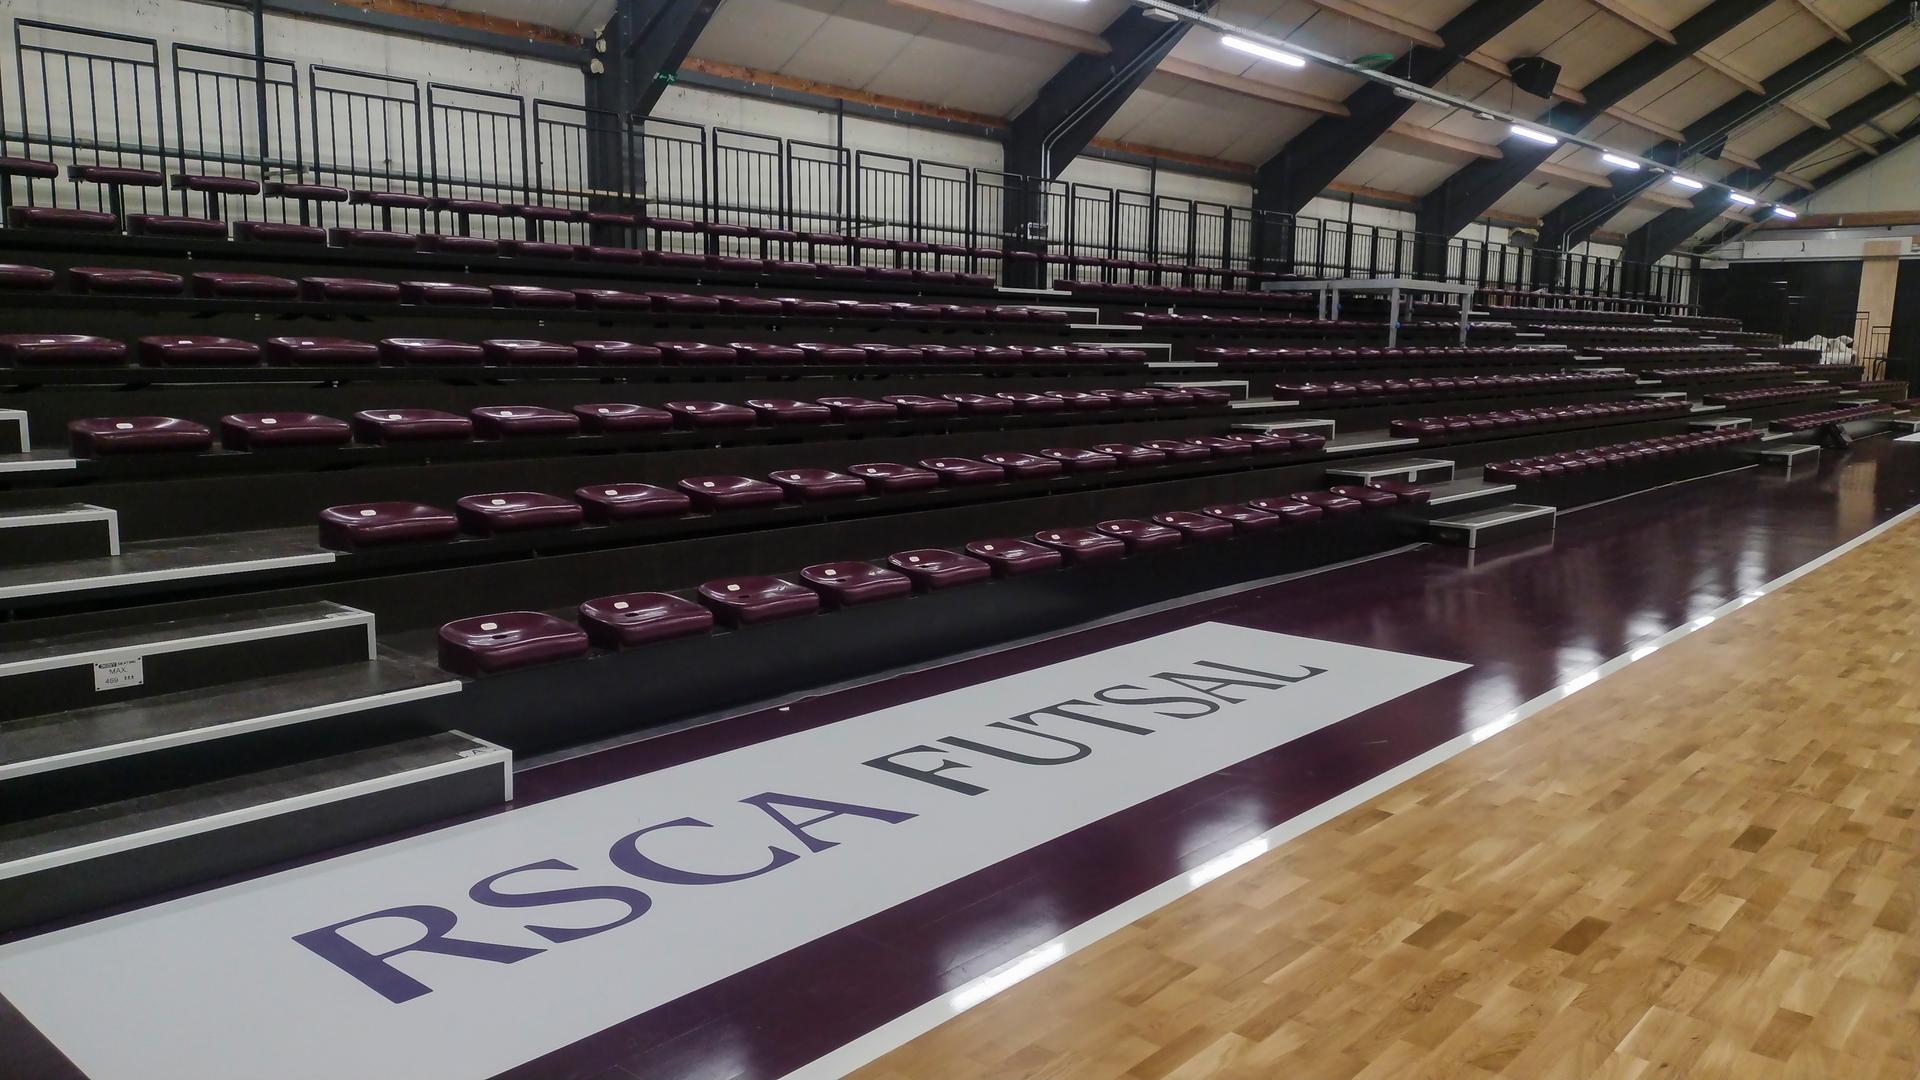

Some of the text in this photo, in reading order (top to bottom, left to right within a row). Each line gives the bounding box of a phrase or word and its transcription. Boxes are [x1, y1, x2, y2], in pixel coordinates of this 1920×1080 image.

[109, 666, 127, 674] MAX
[292, 660, 1328, 1004] RSCA FUTSAL
